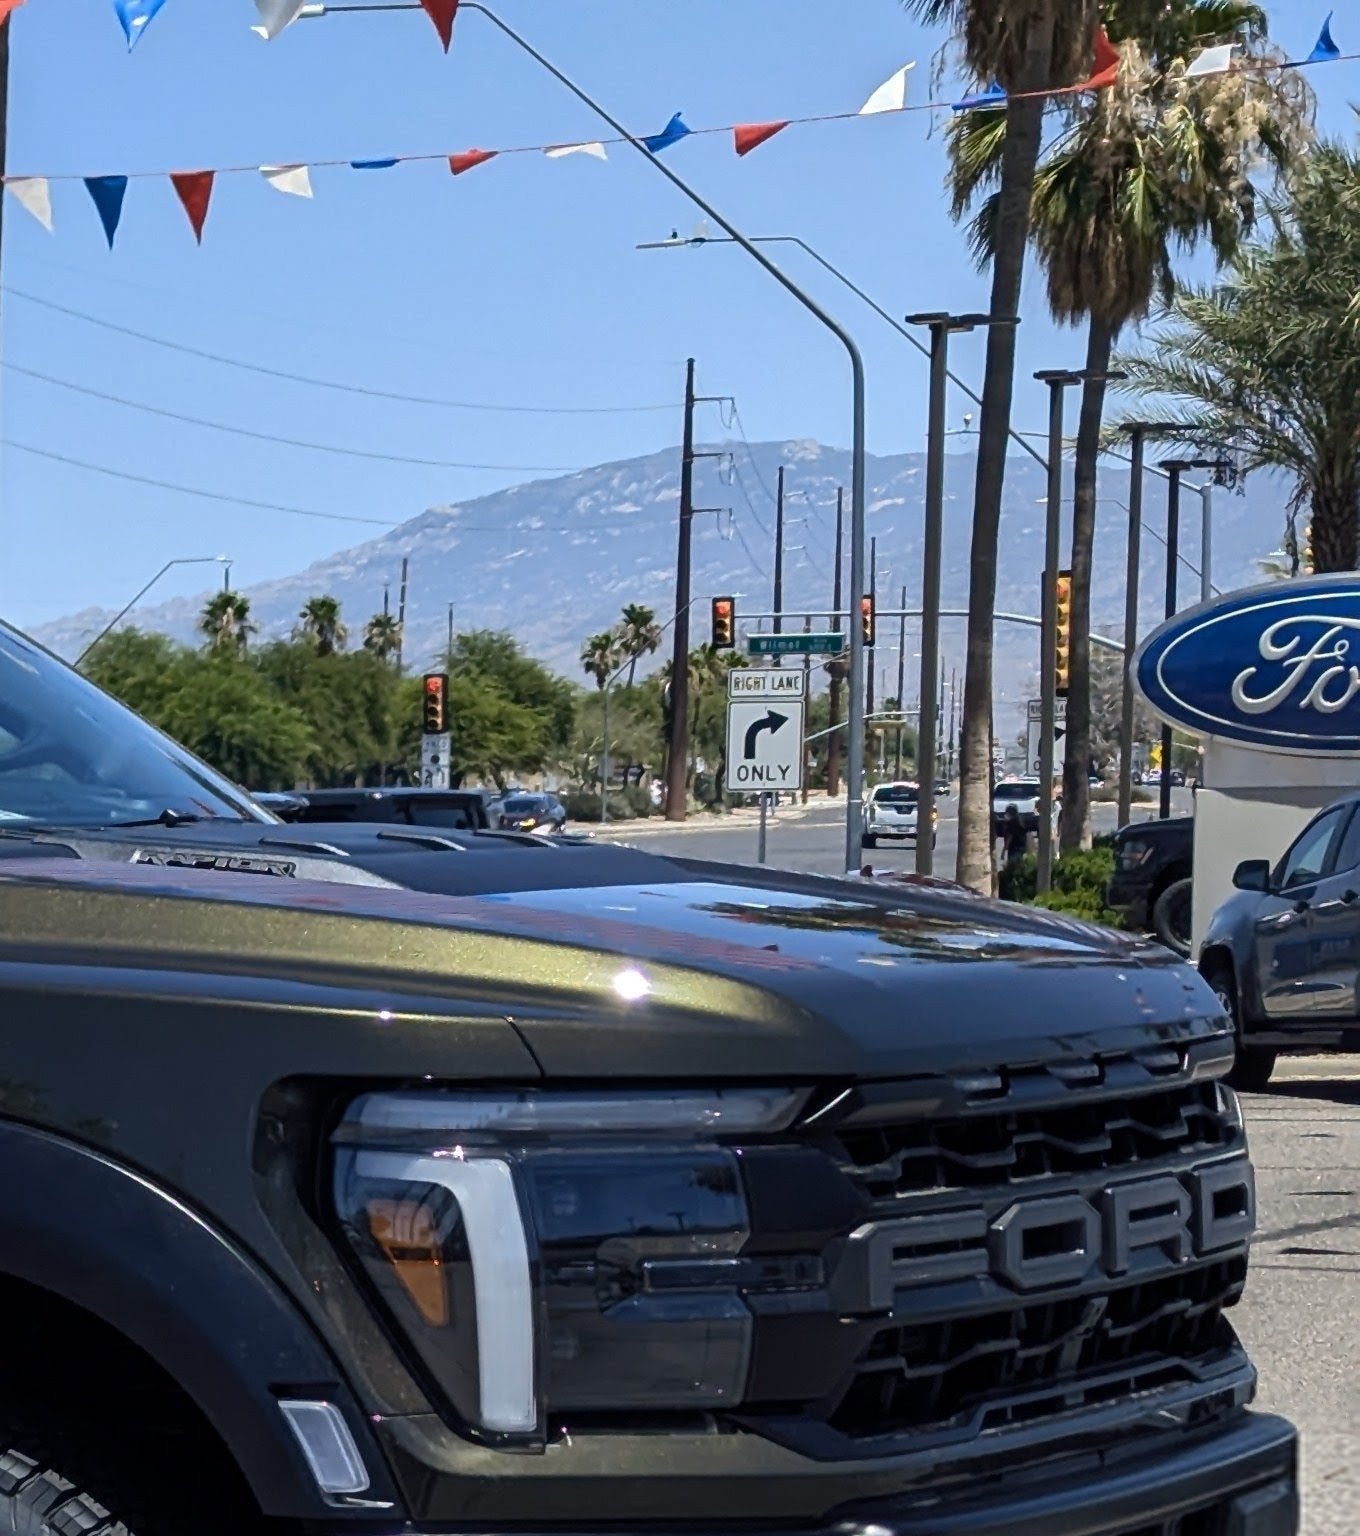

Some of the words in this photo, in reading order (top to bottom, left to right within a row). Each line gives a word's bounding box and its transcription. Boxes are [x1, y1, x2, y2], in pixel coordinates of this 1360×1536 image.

[1231, 614, 1360, 714] Fo
[733, 676, 767, 691] RIGHT
[771, 675, 801, 690] LANE
[736, 764, 791, 782] ONLY
[129, 850, 297, 878] RAPTOR
[840, 1162, 1256, 1312] FORD
